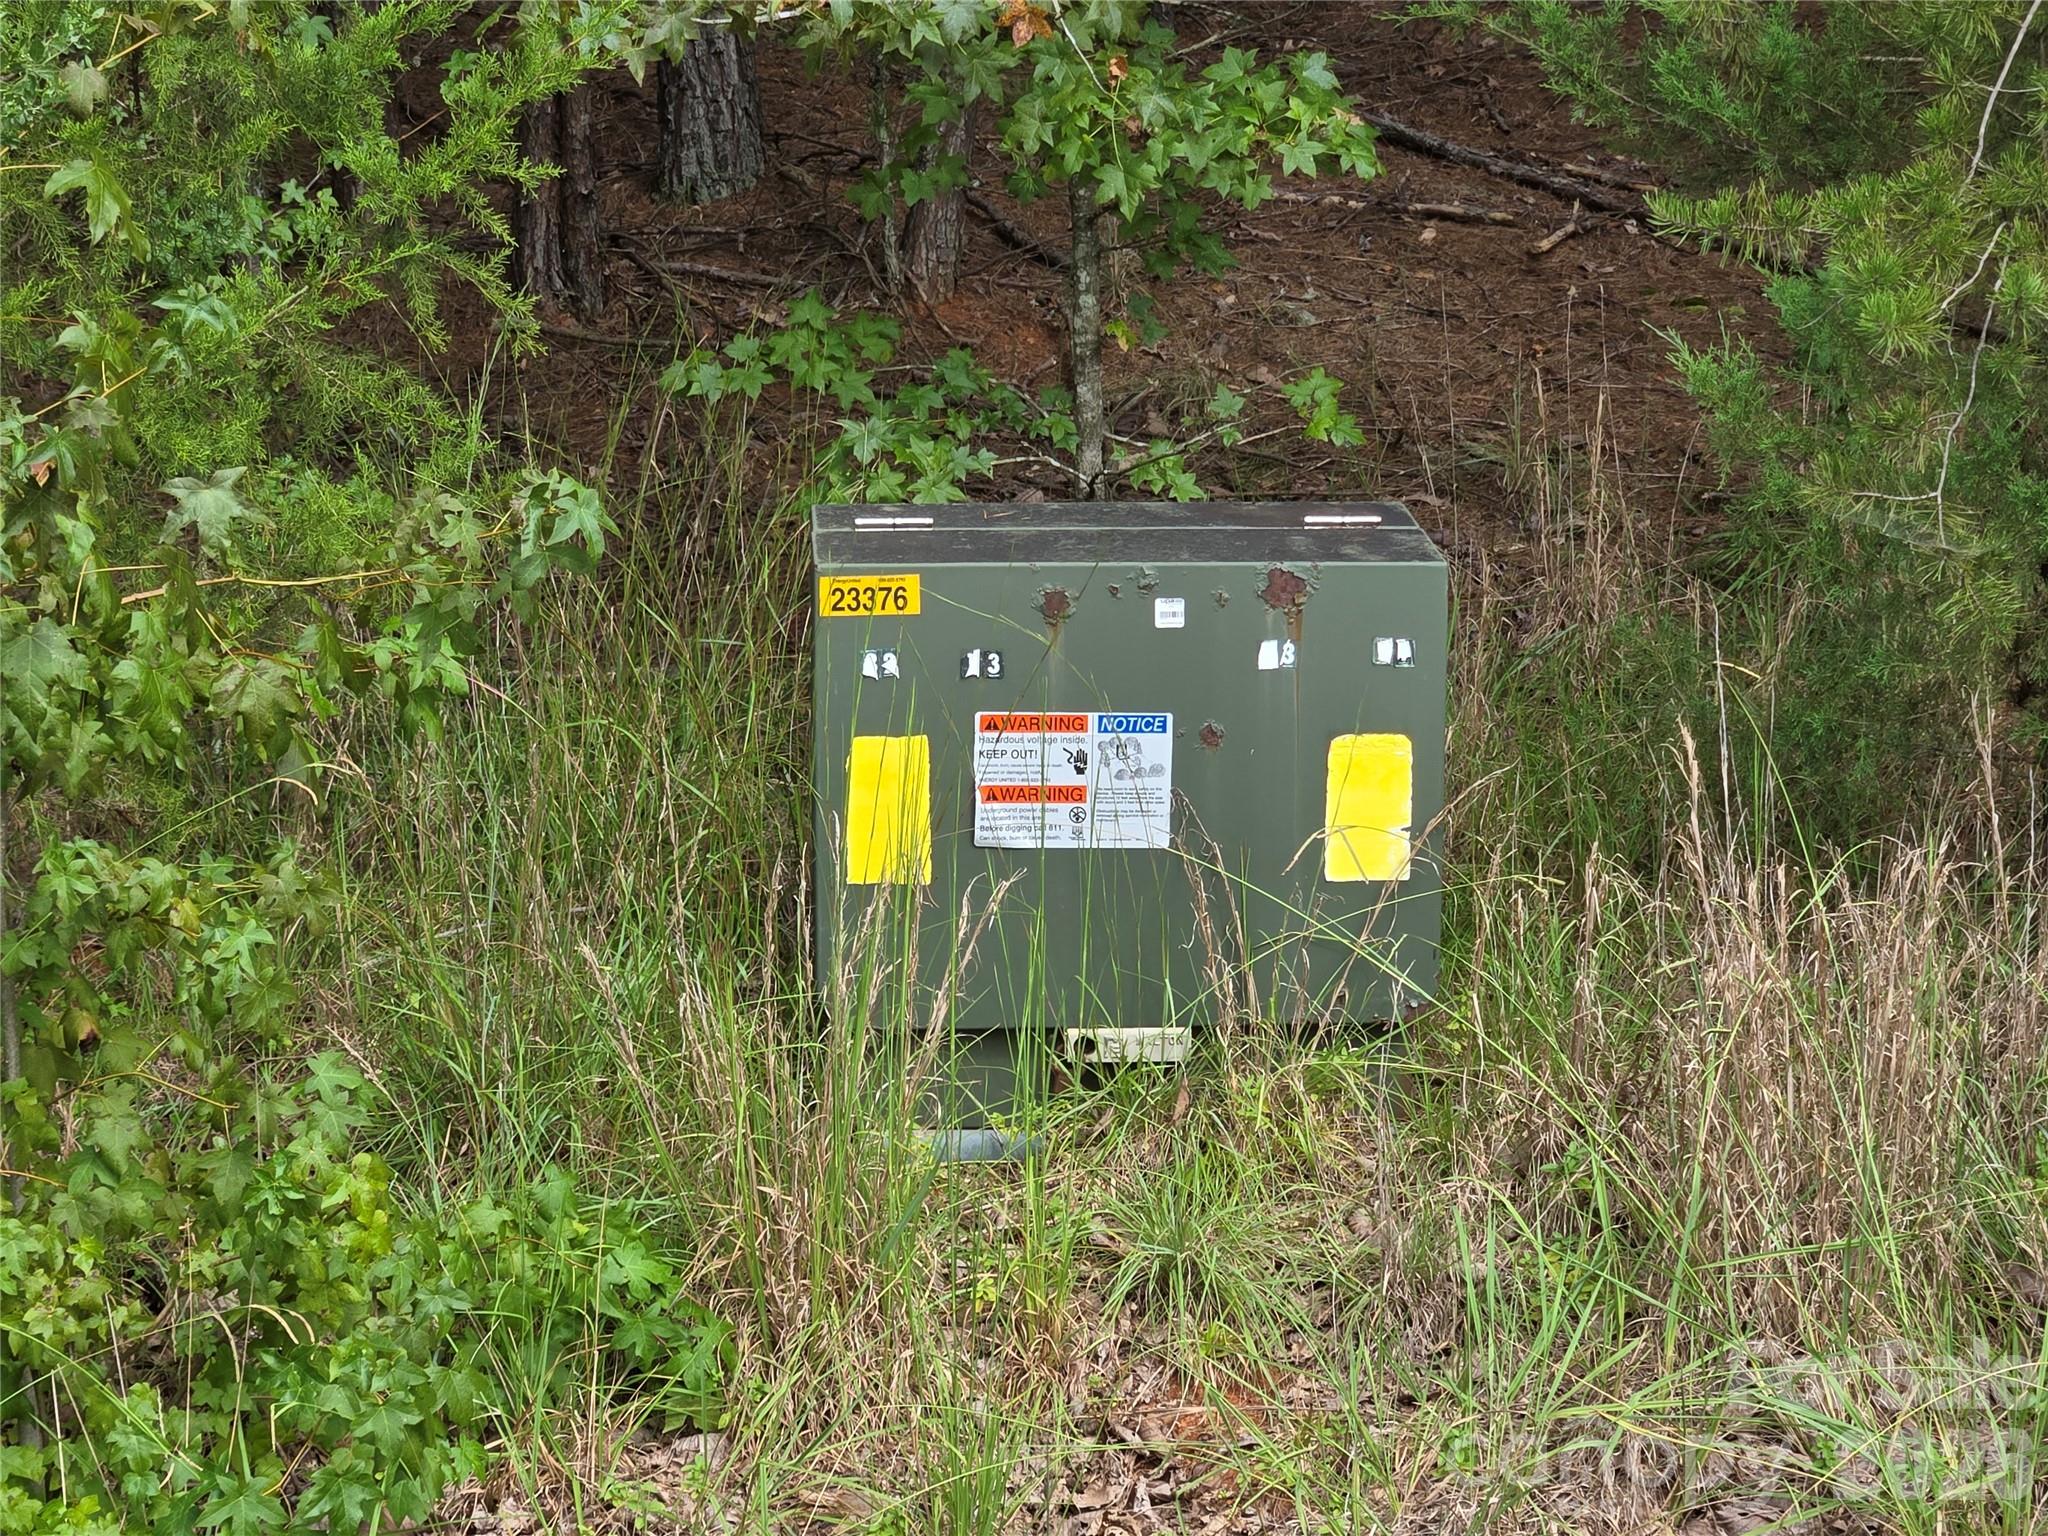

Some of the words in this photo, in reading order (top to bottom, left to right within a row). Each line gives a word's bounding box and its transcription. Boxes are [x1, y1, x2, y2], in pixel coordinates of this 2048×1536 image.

[831, 586, 908, 611] 23376
[1001, 716, 1084, 731] WARNING
[1100, 717, 1165, 732] NOTICE
[979, 735, 1025, 744] Hazardous
[1060, 735, 1088, 744] inside.
[979, 749, 1008, 759] KEEP
[1010, 749, 1038, 759] OUT!
[999, 787, 1083, 802] WARNING
[1005, 824, 1032, 833] digging
